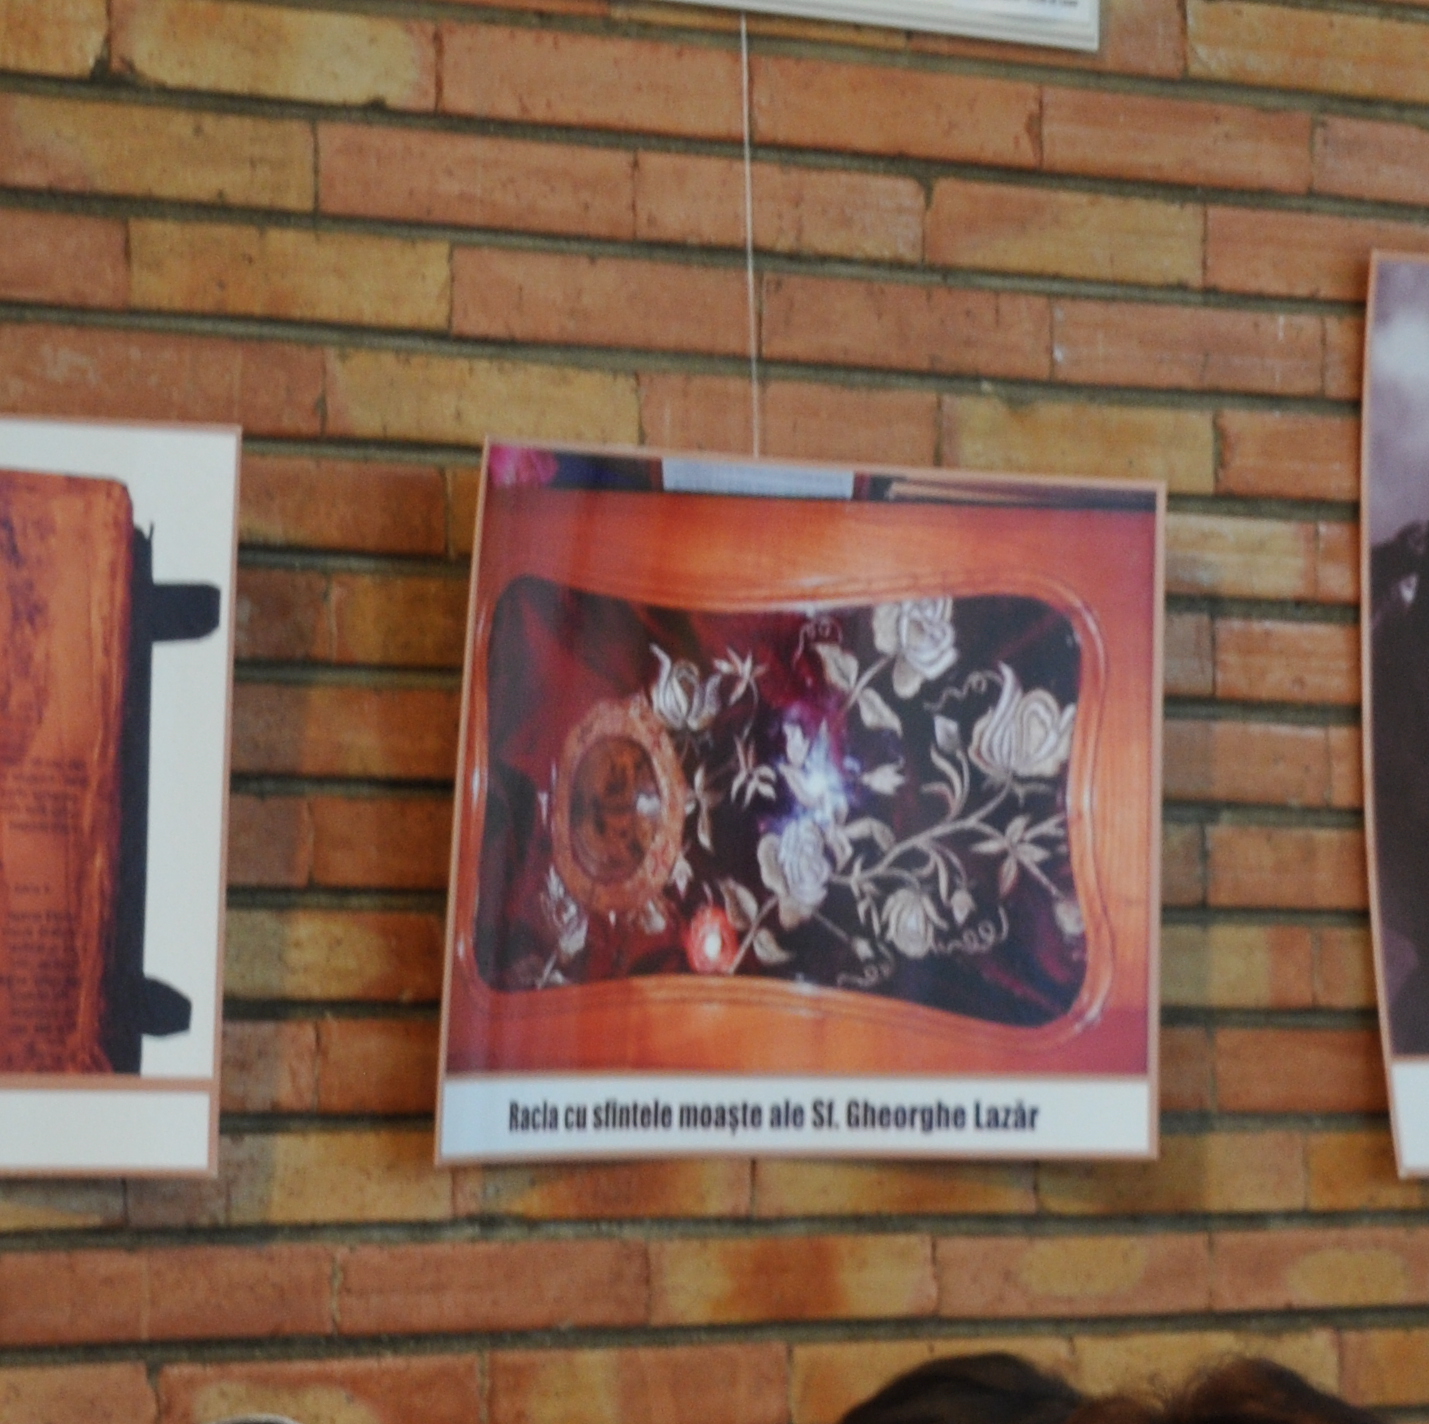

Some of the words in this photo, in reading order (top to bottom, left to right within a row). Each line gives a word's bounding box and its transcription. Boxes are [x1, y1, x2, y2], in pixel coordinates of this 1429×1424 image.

[507, 1100, 559, 1132] Racla
[563, 1105, 588, 1132] cu
[592, 1099, 673, 1132] sfintele
[769, 1098, 805, 1131] ale
[845, 1099, 967, 1134] Gheorghe
